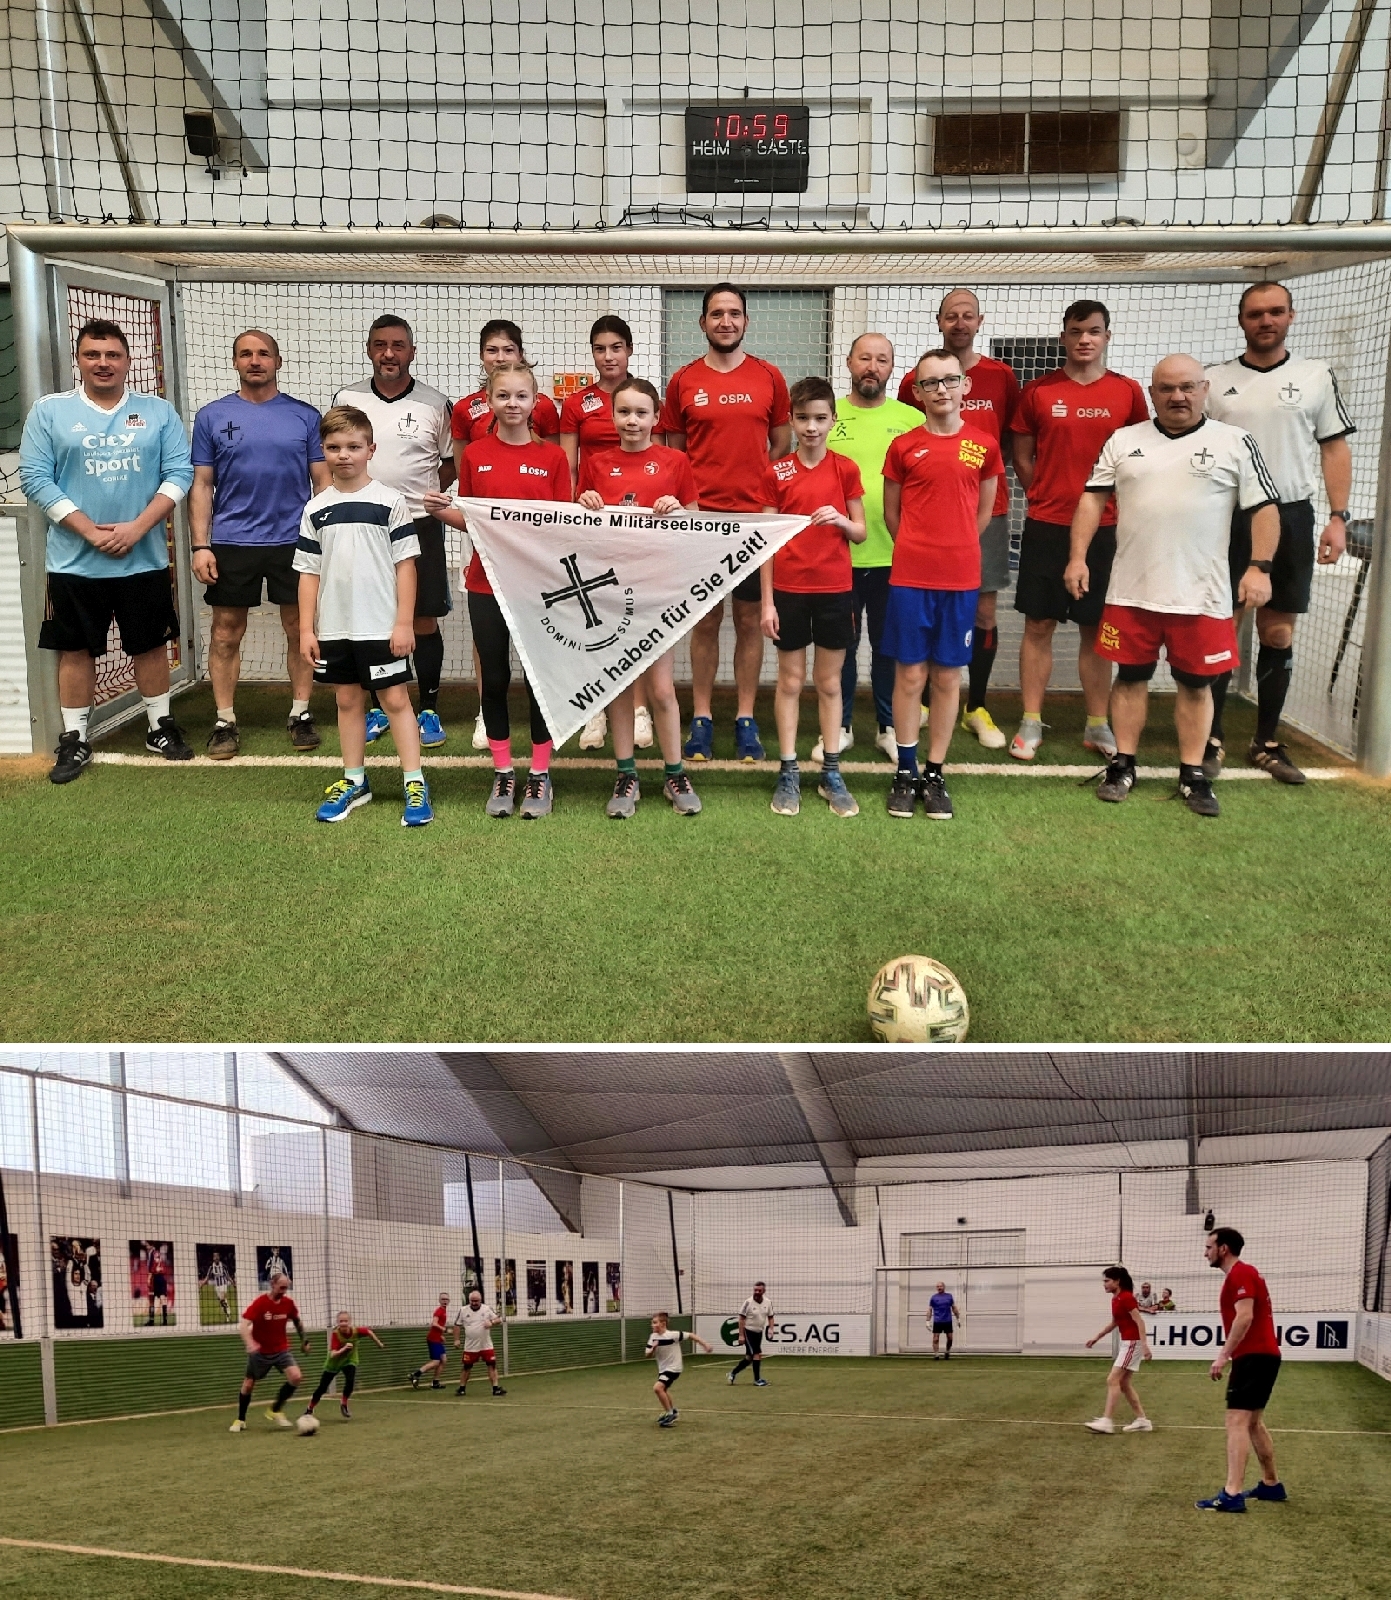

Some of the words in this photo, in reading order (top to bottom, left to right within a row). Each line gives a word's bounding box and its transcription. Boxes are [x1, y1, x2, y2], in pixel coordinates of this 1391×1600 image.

[713, 114, 789, 138] 10:59
[692, 140, 730, 156] HEIM
[757, 138, 807, 156] GÄSTE
[718, 393, 753, 405] OSPA
[1076, 407, 1111, 419] OSPA
[84, 453, 141, 477] Sport
[528, 467, 548, 477] OSPA
[490, 506, 603, 527] Evangelische
[609, 513, 741, 535] Militärseelsorge
[568, 679, 606, 712] Wir
[603, 627, 664, 682] haben
[660, 599, 692, 630] für
[690, 572, 724, 602] Sie
[720, 530, 768, 575] Zeit!
[617, 587, 635, 635] SUMUS
[778, 1346, 805, 1354] UNSERE
[808, 1345, 840, 1354] ENERGIE
